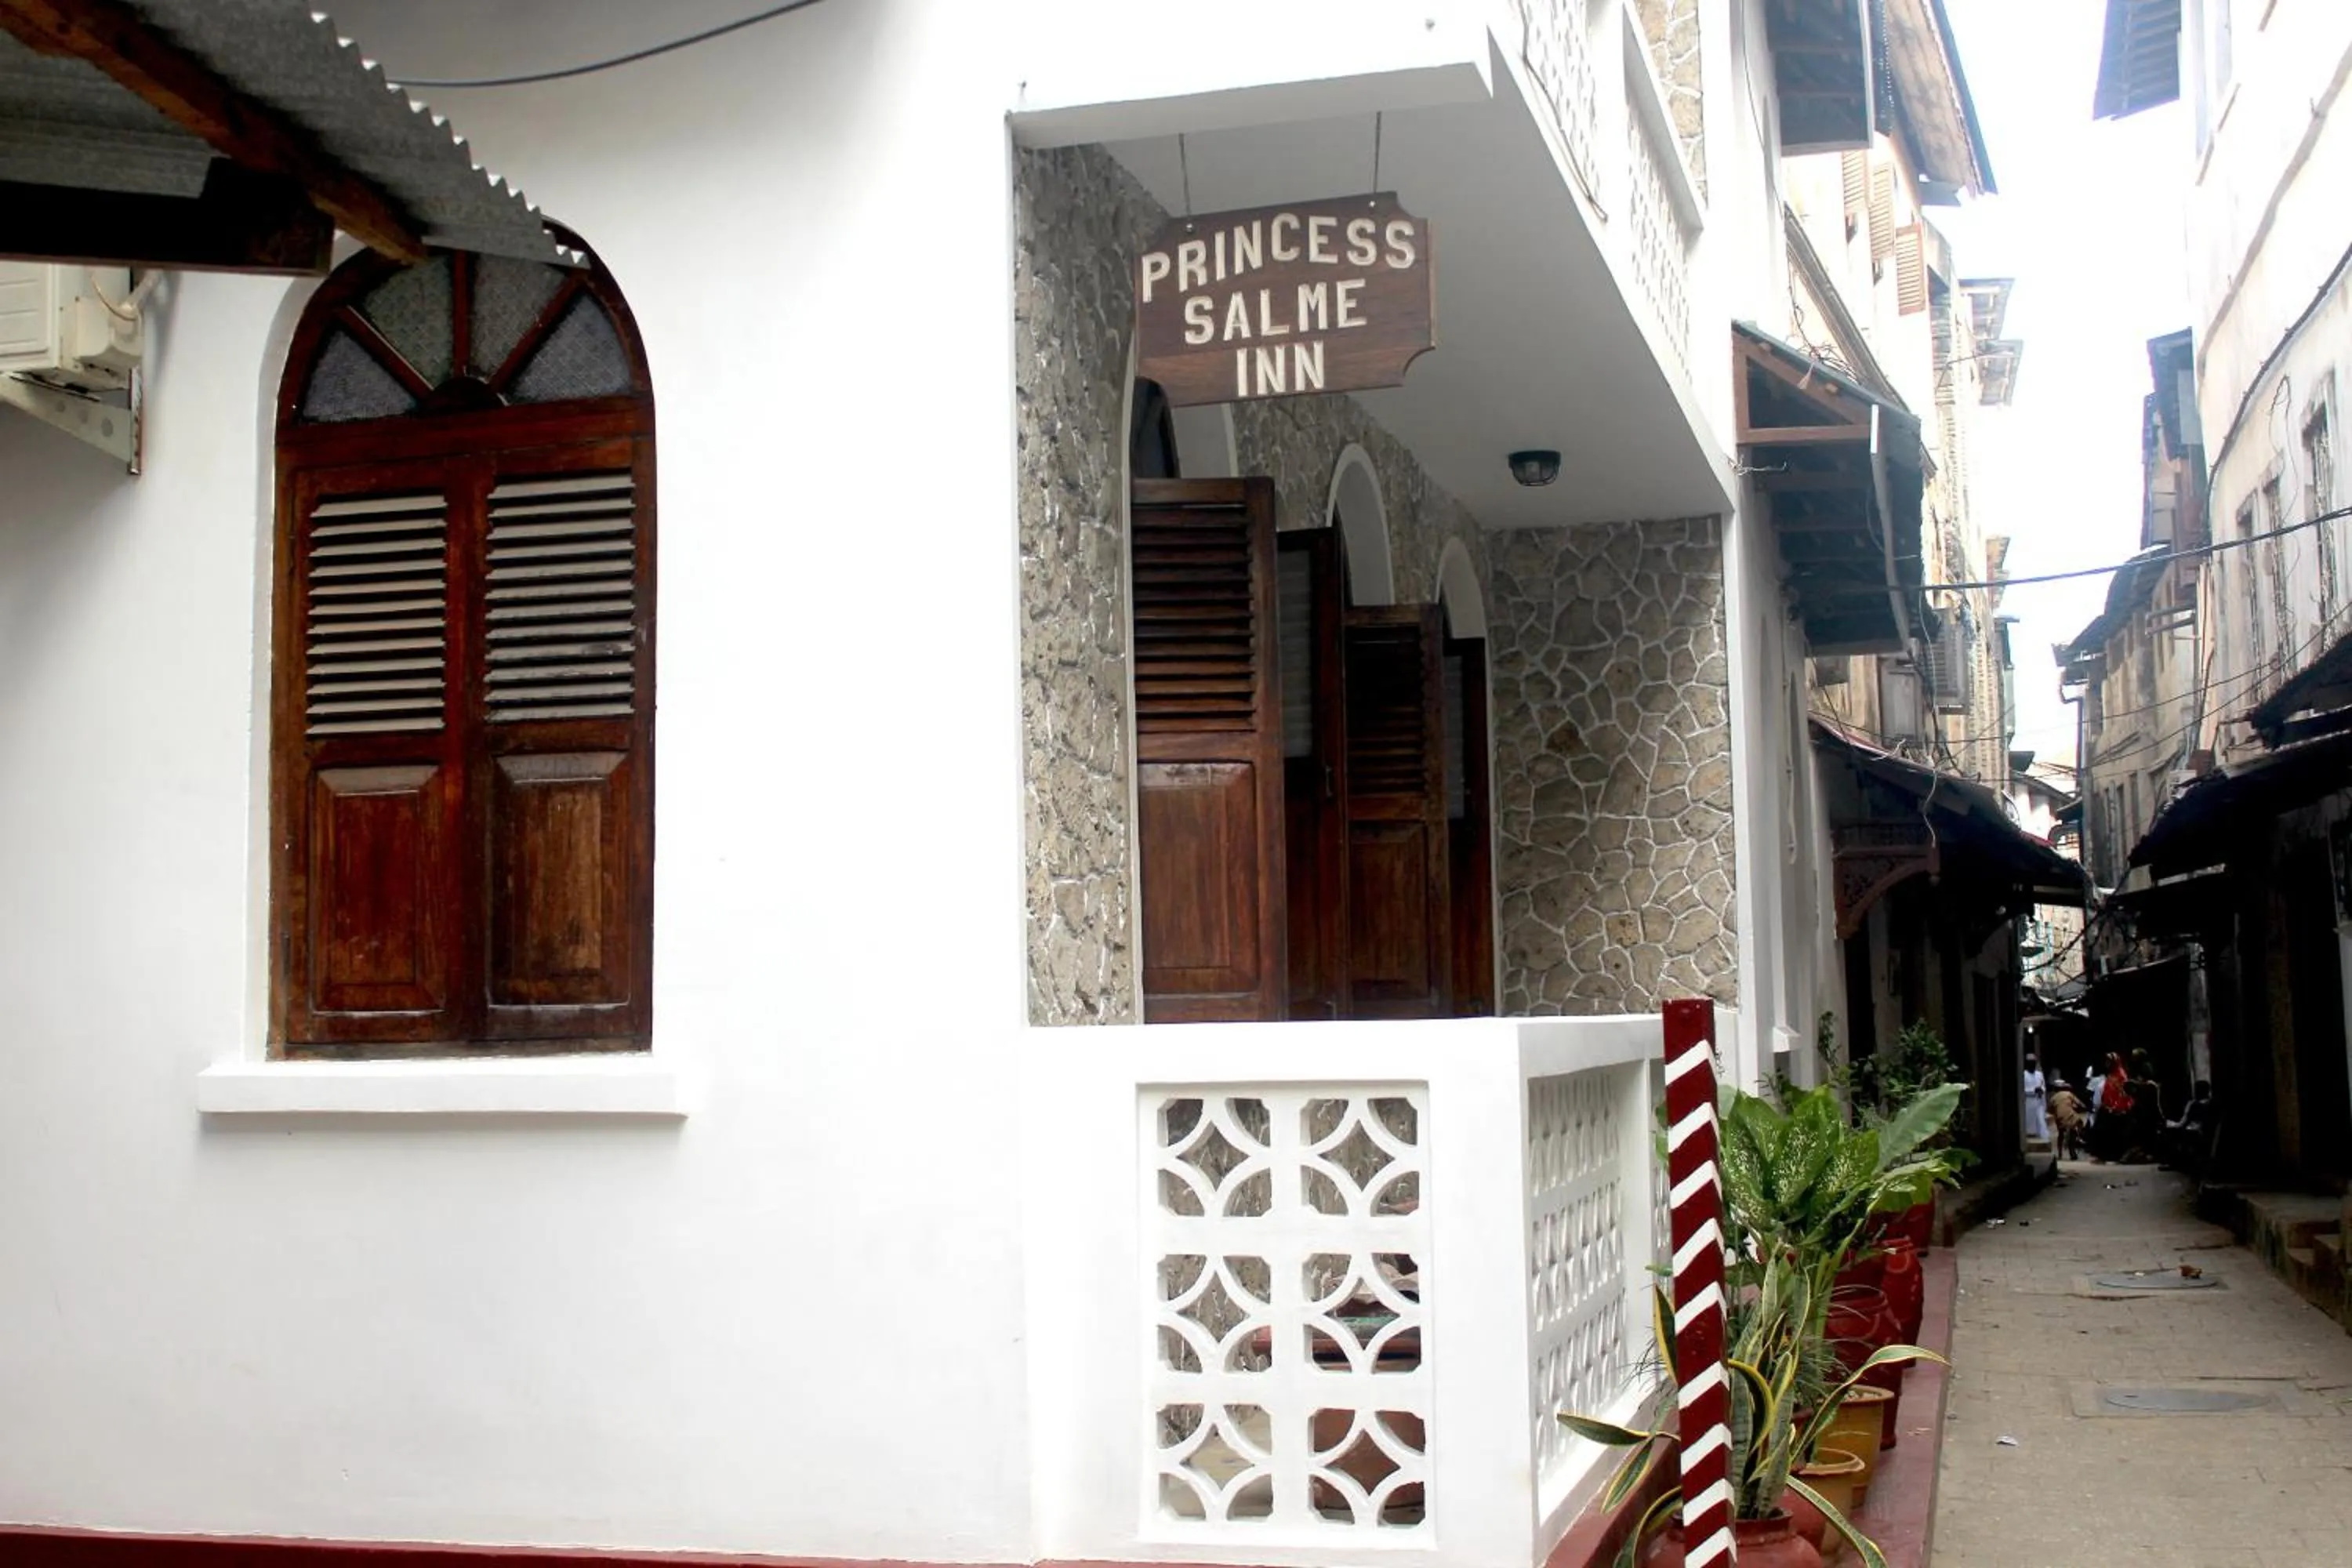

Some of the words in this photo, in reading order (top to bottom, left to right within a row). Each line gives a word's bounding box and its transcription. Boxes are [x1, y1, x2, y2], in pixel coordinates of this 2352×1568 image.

[1142, 212, 1416, 303] PRINCESS
[1185, 278, 1368, 344] SALME
[1236, 341, 1325, 397] INN
